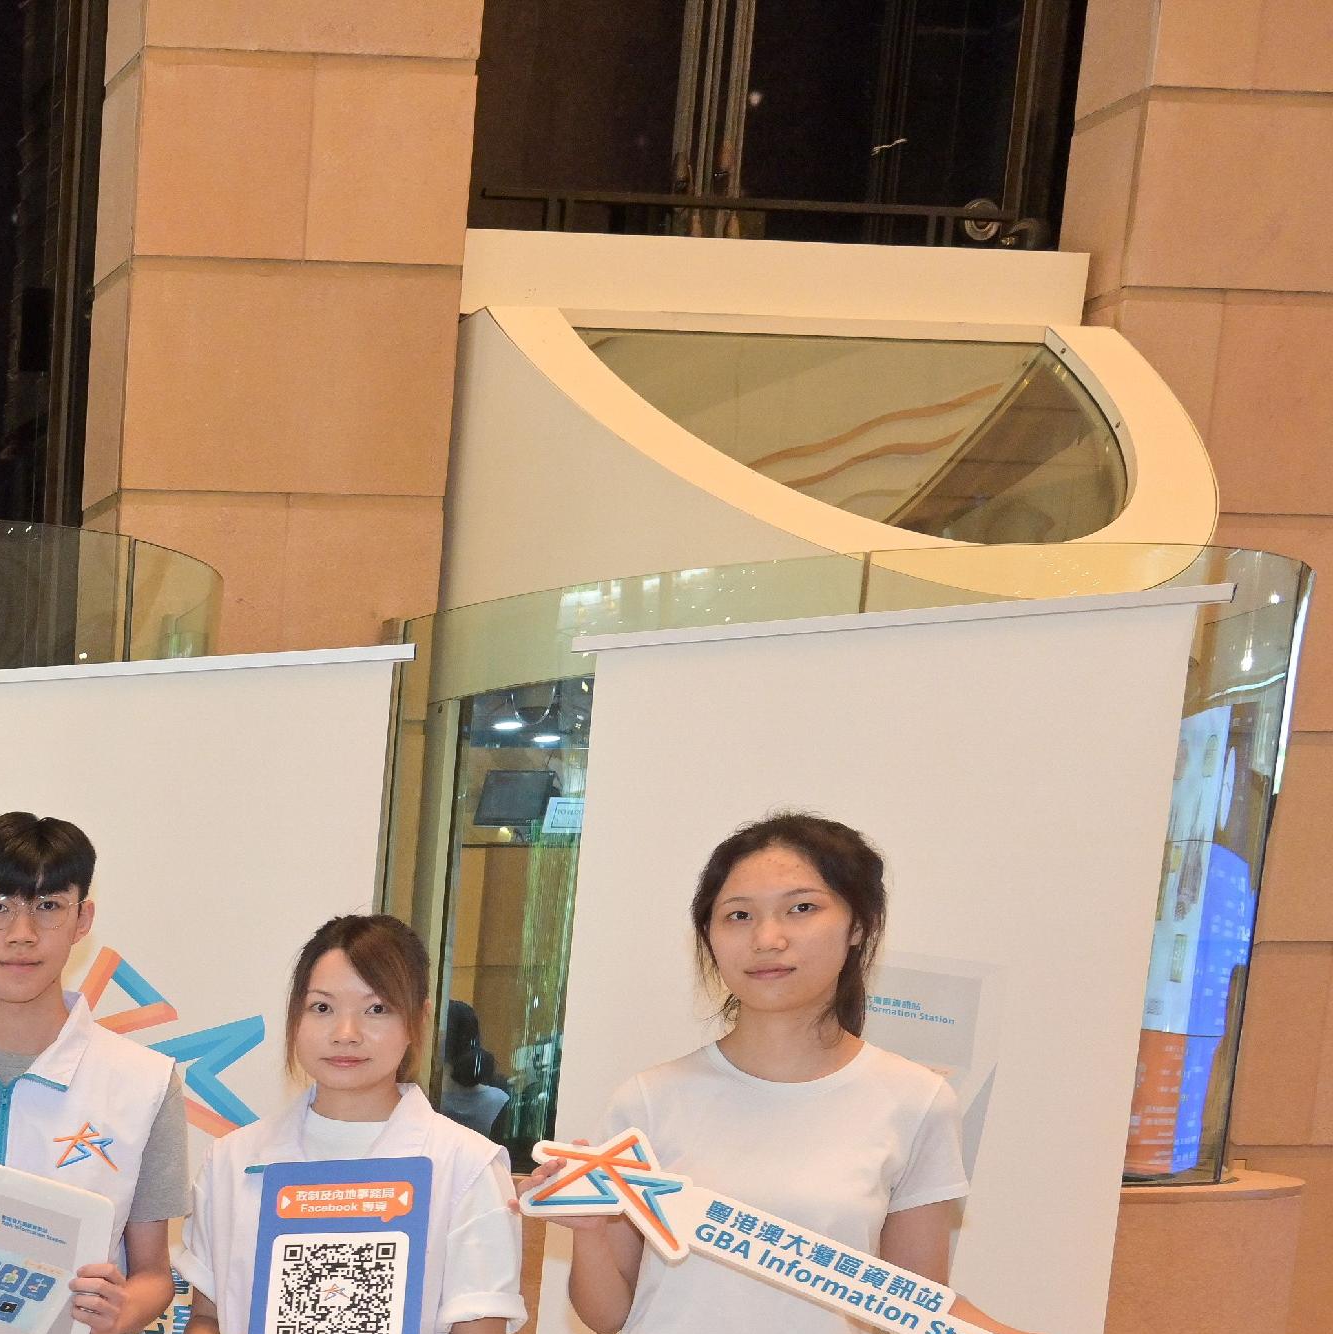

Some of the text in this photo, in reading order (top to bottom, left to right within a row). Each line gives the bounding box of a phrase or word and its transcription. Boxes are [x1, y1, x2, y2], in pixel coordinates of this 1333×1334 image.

[864, 1004, 955, 1025] formation Station
[301, 1202, 357, 1212] Facebook
[695, 1223, 751, 1260] GBA
[757, 1247, 919, 1330] Information
[705, 1200, 945, 1313] 粵港澳大灣區資訊站
